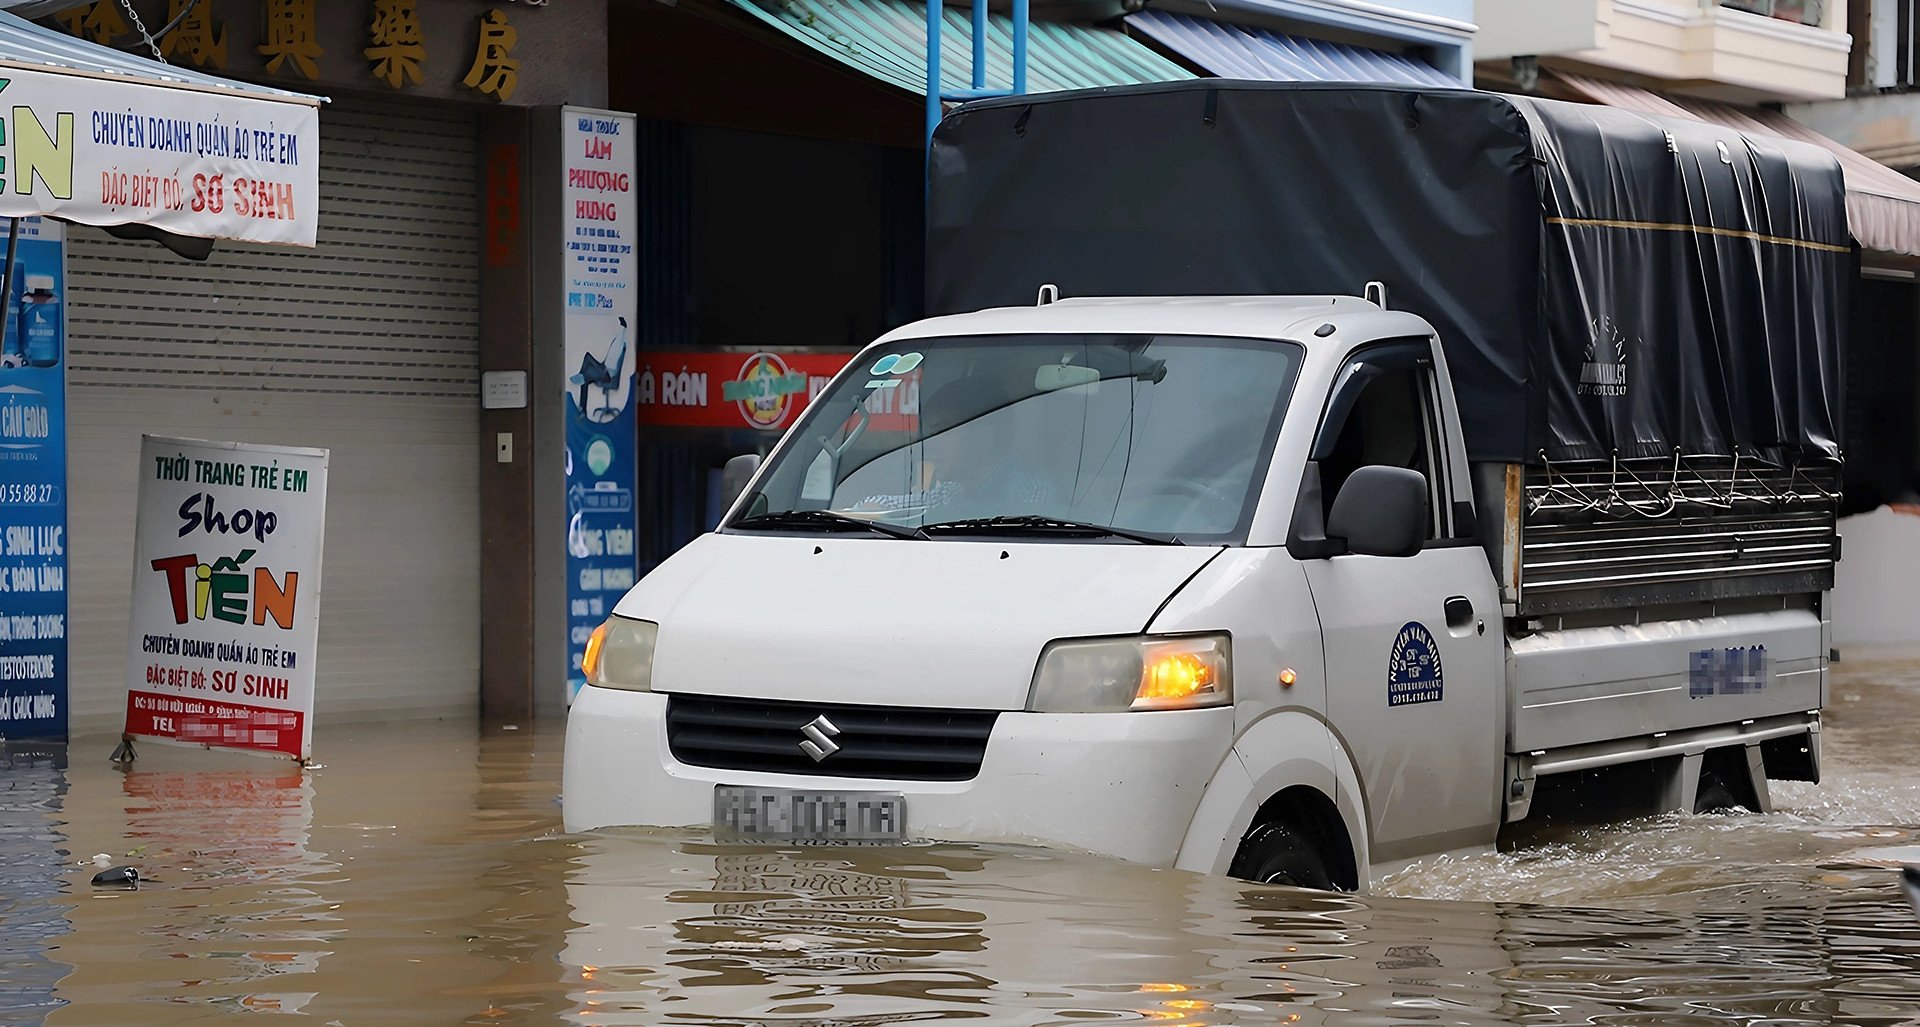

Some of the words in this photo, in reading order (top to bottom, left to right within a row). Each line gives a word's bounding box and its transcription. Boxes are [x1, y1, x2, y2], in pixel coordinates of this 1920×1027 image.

[0, 78, 74, 200] N
[149, 116, 192, 153] DOANH
[233, 121, 249, 160] ÁO
[279, 134, 298, 166] EM
[233, 177, 295, 221] SINH
[662, 365, 708, 406] RÁN
[156, 453, 190, 482] THỜI
[194, 460, 245, 487] TRANG
[250, 459, 279, 490] TRẺ
[283, 469, 308, 492] EM
[9, 484, 21, 503] 55
[23, 484, 37, 503] 88
[39, 484, 52, 503] 27
[178, 492, 277, 543] Shop
[182, 638, 215, 660] DOANH
[245, 643, 258, 664] ÁO
[262, 644, 279, 667] TRẺ
[282, 651, 296, 669] EM
[211, 670, 238, 694] SƠ
[243, 674, 289, 700] SINH
[152, 716, 176, 732] TEL
